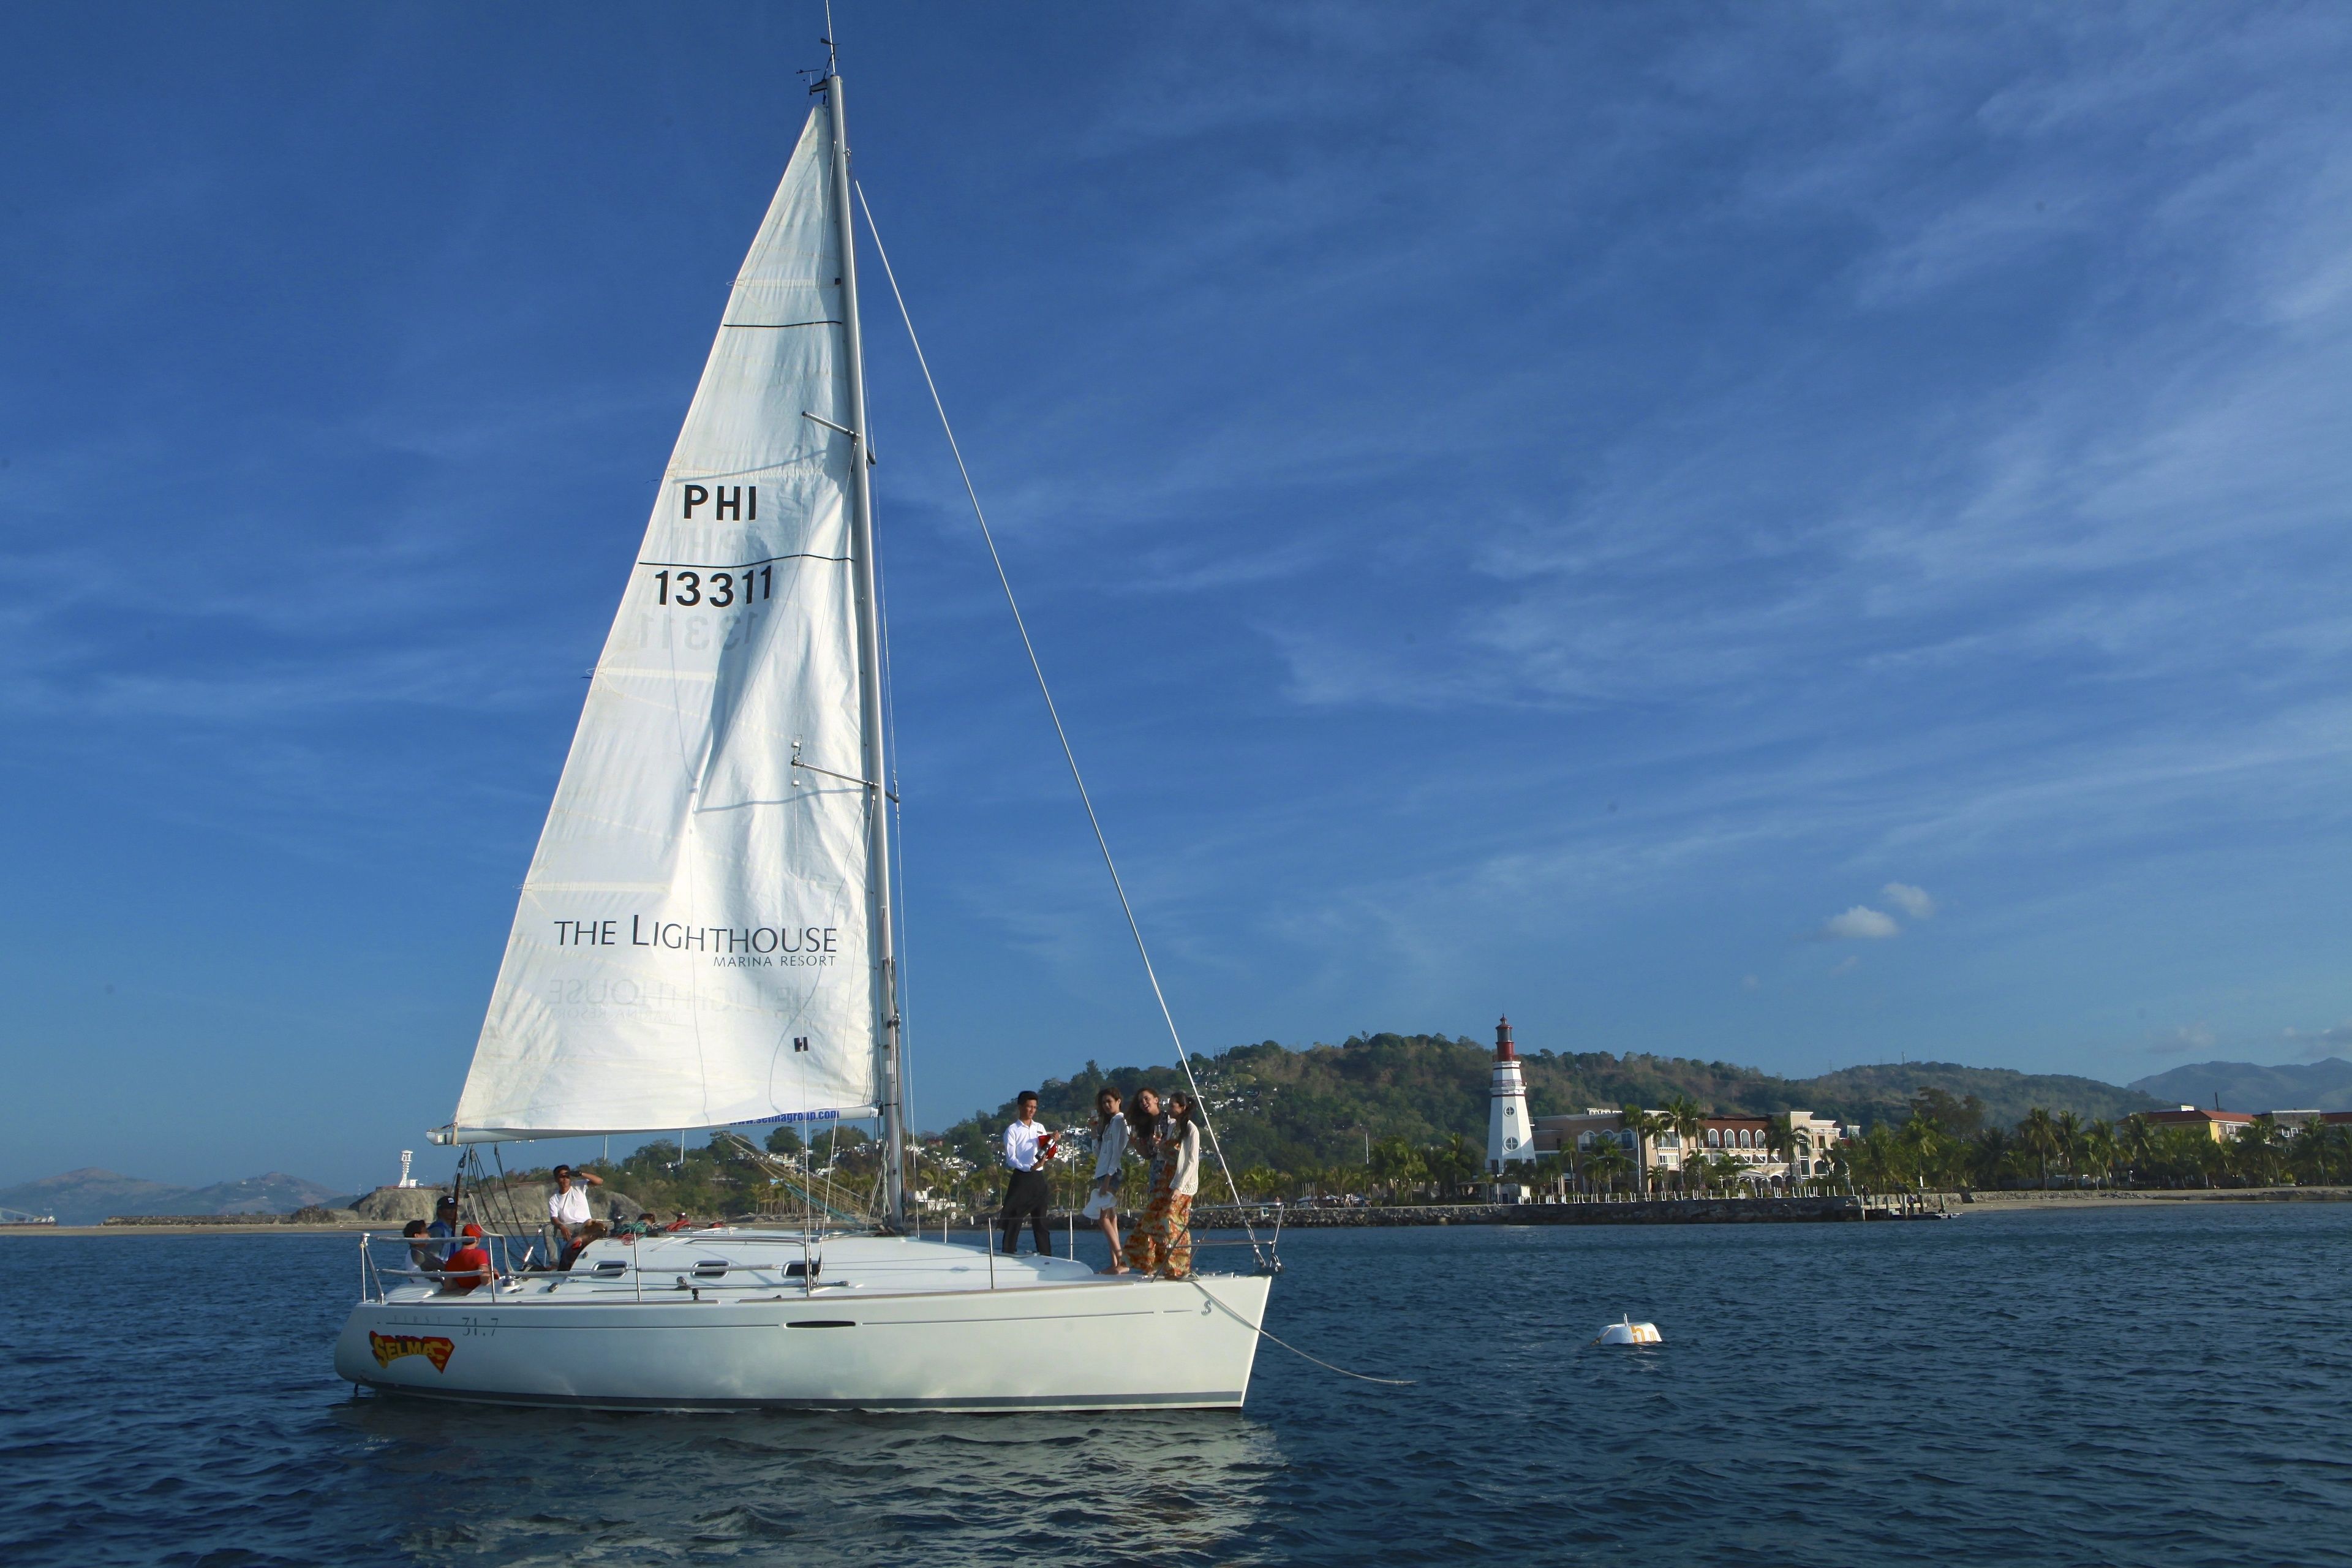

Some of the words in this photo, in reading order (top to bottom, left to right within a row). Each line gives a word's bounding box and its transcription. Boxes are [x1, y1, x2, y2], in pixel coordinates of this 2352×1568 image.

[684, 484, 756, 521] PHI
[655, 565, 772, 607] 13311
[554, 921, 617, 946] THE
[633, 914, 837, 953] LIGHTHOUSE
[714, 956, 772, 967] MARINA
[780, 956, 836, 967] RESORT
[462, 1317, 499, 1336] 31.7
